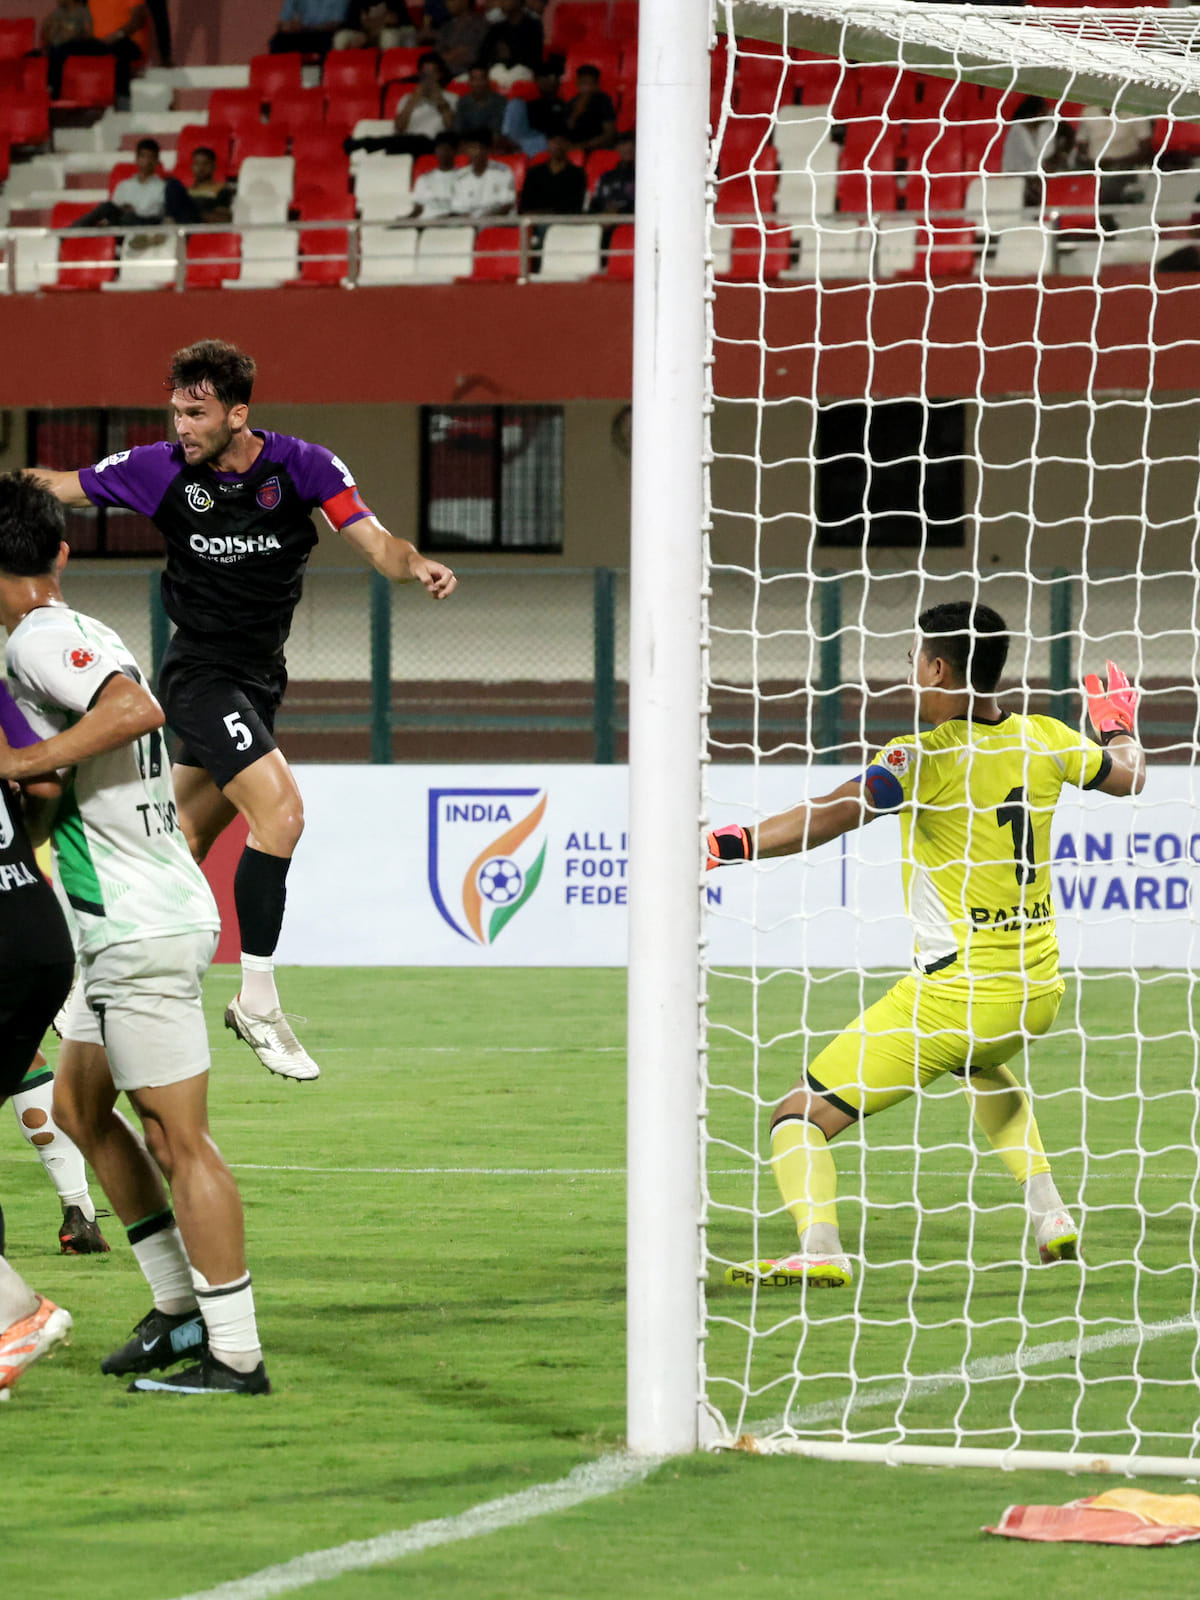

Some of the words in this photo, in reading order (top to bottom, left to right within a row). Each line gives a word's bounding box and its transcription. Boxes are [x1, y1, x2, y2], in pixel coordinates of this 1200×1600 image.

[189, 534, 282, 555] ODISHA
[223, 711, 253, 751] 5
[446, 804, 512, 823] INDIA
[565, 832, 612, 851] ALL
[996, 786, 1036, 886] 1
[566, 859, 628, 878] FOOT
[1051, 876, 1192, 910] WARD
